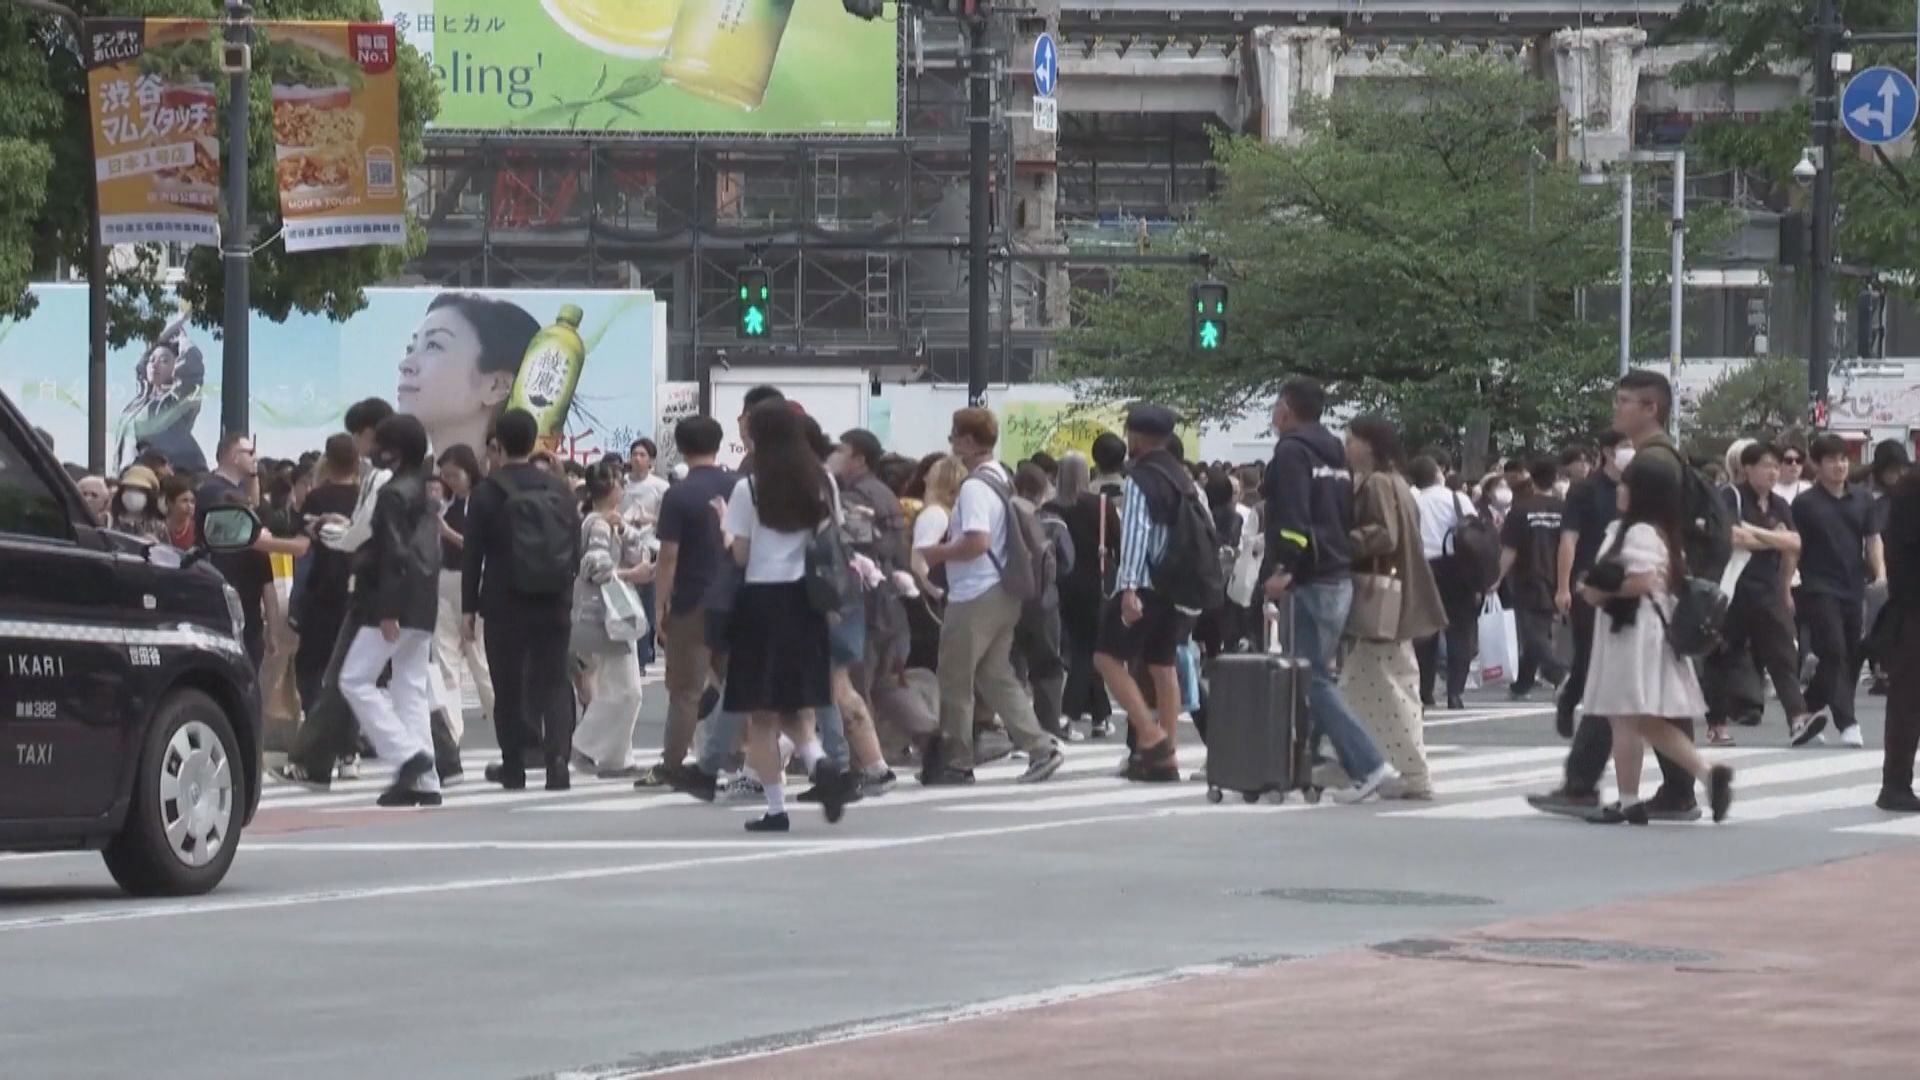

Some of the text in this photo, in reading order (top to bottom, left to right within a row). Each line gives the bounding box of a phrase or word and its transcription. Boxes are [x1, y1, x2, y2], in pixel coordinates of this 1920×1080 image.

[394, 11, 506, 33] 多田ヒカル
[357, 50, 389, 64] No.1
[99, 73, 165, 113] 渋谷
[325, 195, 361, 207] TOUCH
[8, 653, 65, 678] IKARI
[16, 743, 53, 765] TAXI
